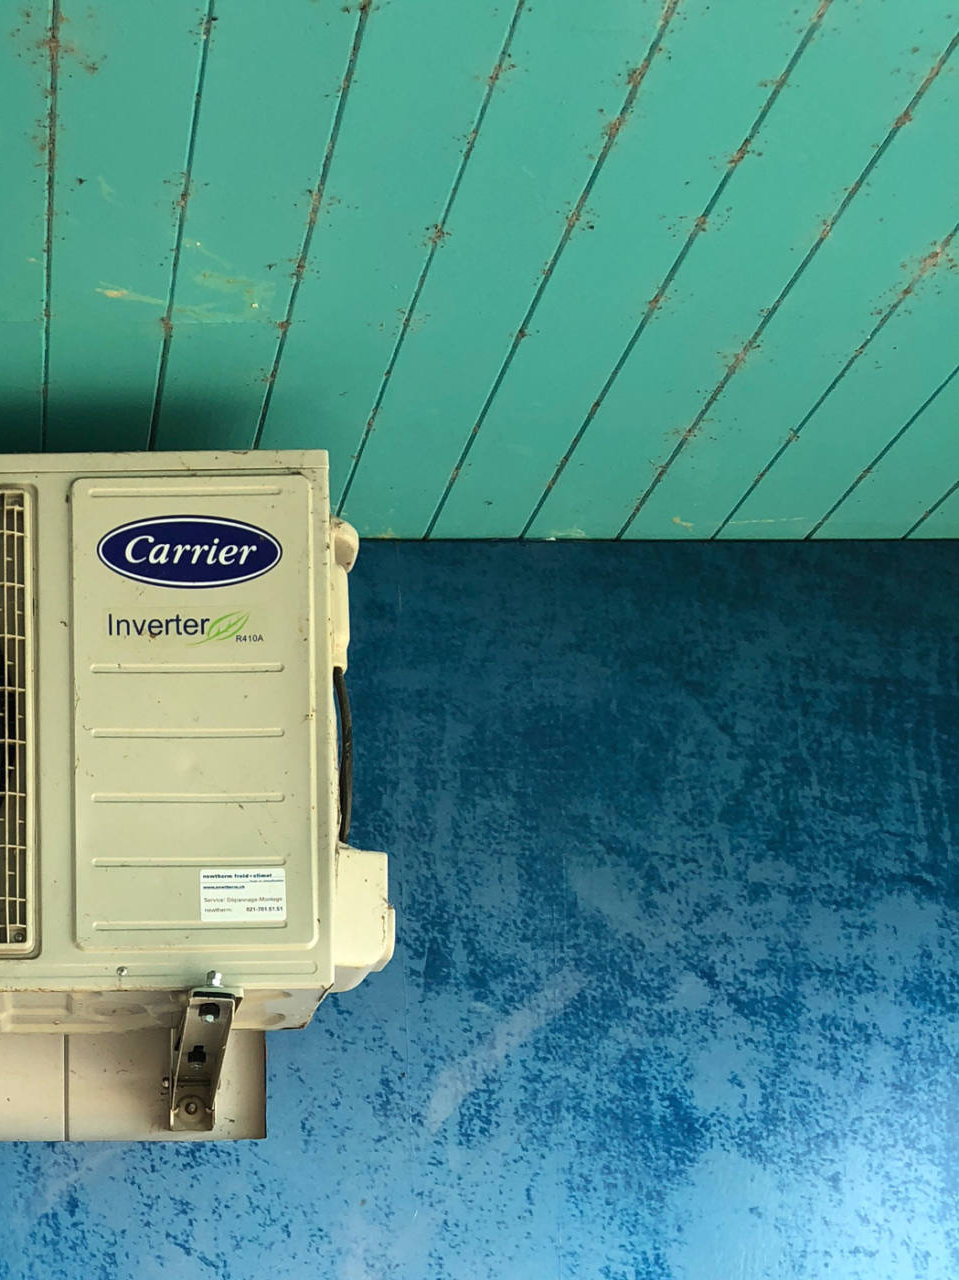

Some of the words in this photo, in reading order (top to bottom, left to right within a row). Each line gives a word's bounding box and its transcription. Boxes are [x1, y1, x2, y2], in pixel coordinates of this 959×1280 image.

[125, 535, 257, 565] Carrier
[108, 614, 210, 636] Inverter
[235, 634, 264, 642] R410A
